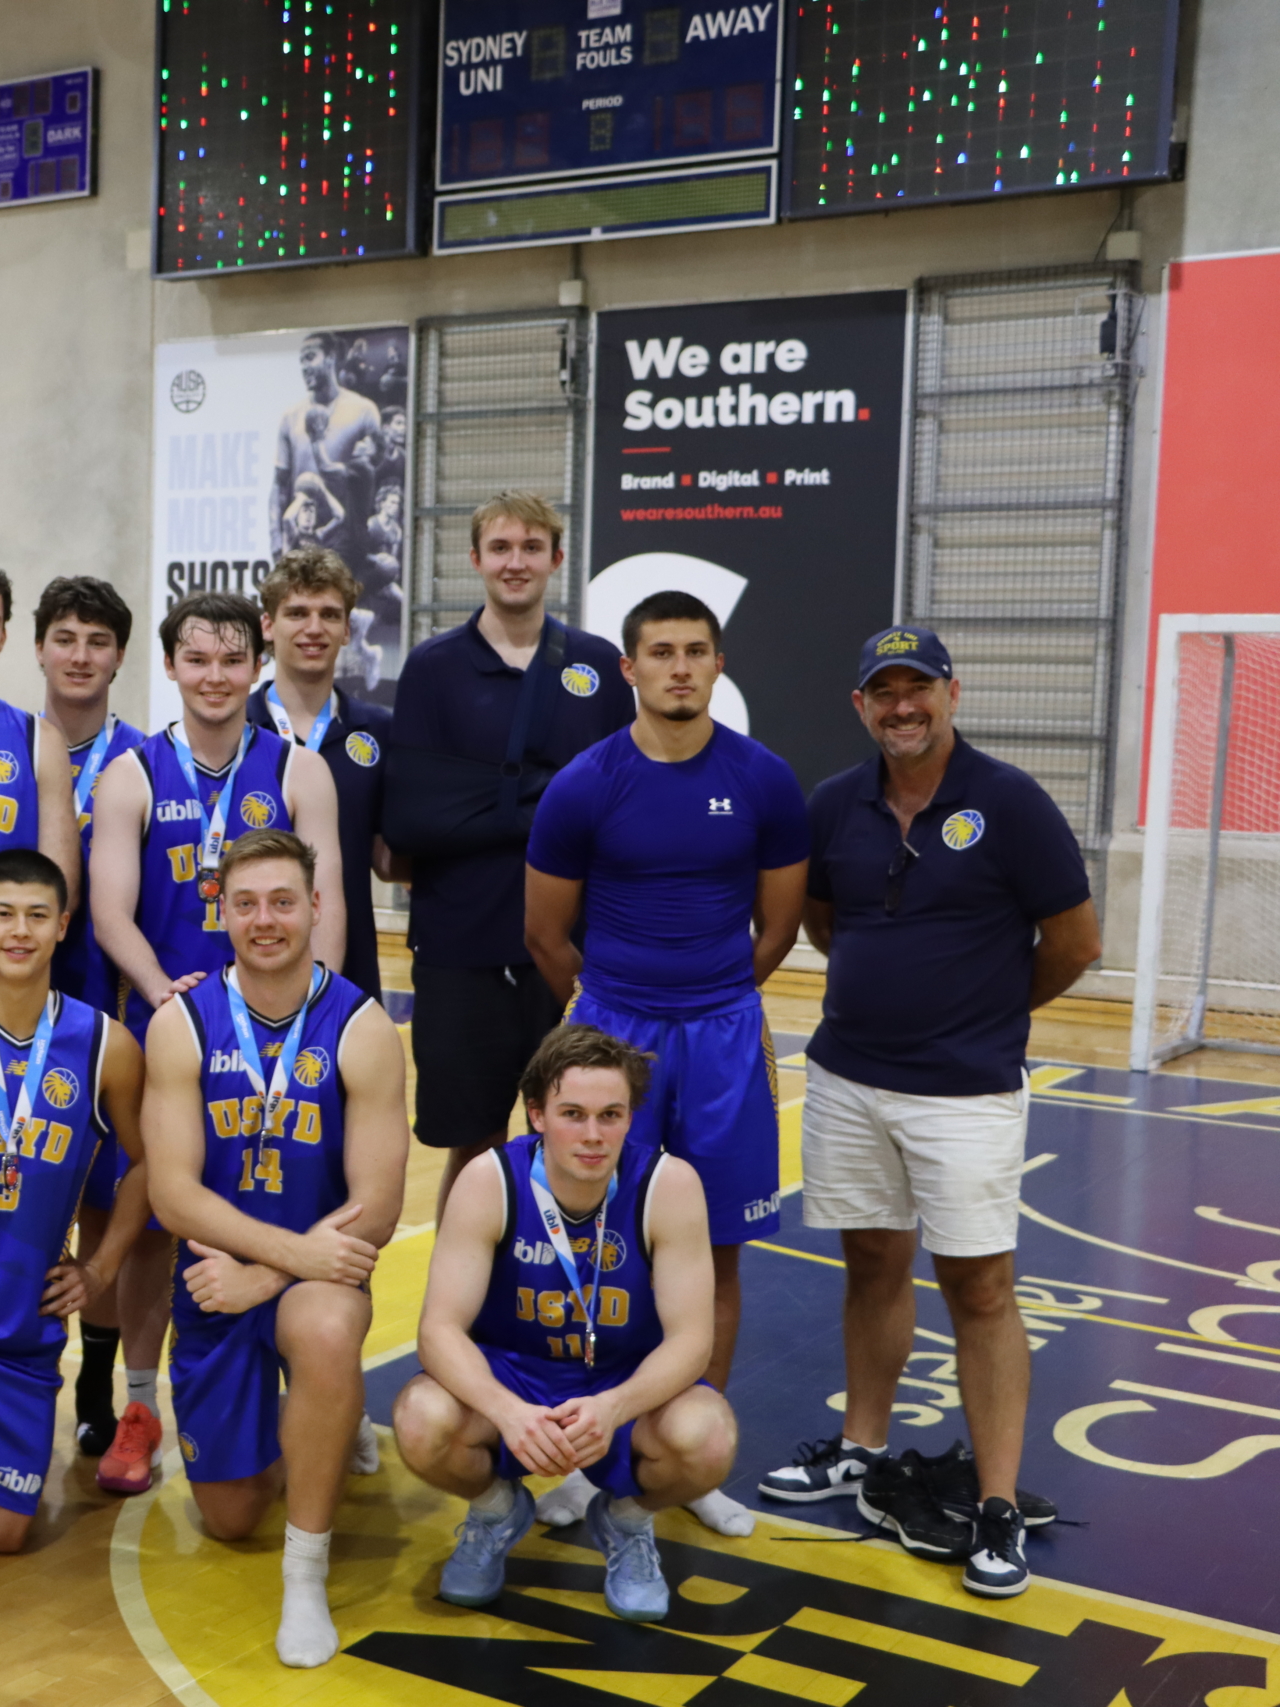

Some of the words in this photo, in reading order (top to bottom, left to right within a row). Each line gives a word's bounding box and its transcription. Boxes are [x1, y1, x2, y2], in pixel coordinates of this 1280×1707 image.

[577, 24, 632, 49] TEAM
[684, 3, 773, 44] AWAY
[444, 30, 527, 67] SYDNEY
[576, 46, 632, 71] FOULS
[459, 65, 503, 96] UNI
[582, 95, 624, 111] PERIOD
[47, 127, 82, 143] DARK
[625, 337, 710, 380] We
[720, 339, 808, 375] are
[623, 383, 870, 431] Southern.
[169, 431, 260, 490] MAKE
[620, 472, 675, 490] Brand
[698, 469, 760, 492] Digital
[784, 468, 830, 486] Print
[168, 496, 258, 554] MORE
[620, 504, 783, 521] wearesouthern.au
[156, 799, 191, 823] ubl
[207, 1096, 322, 1145] USYD
[238, 1148, 283, 1194] 14
